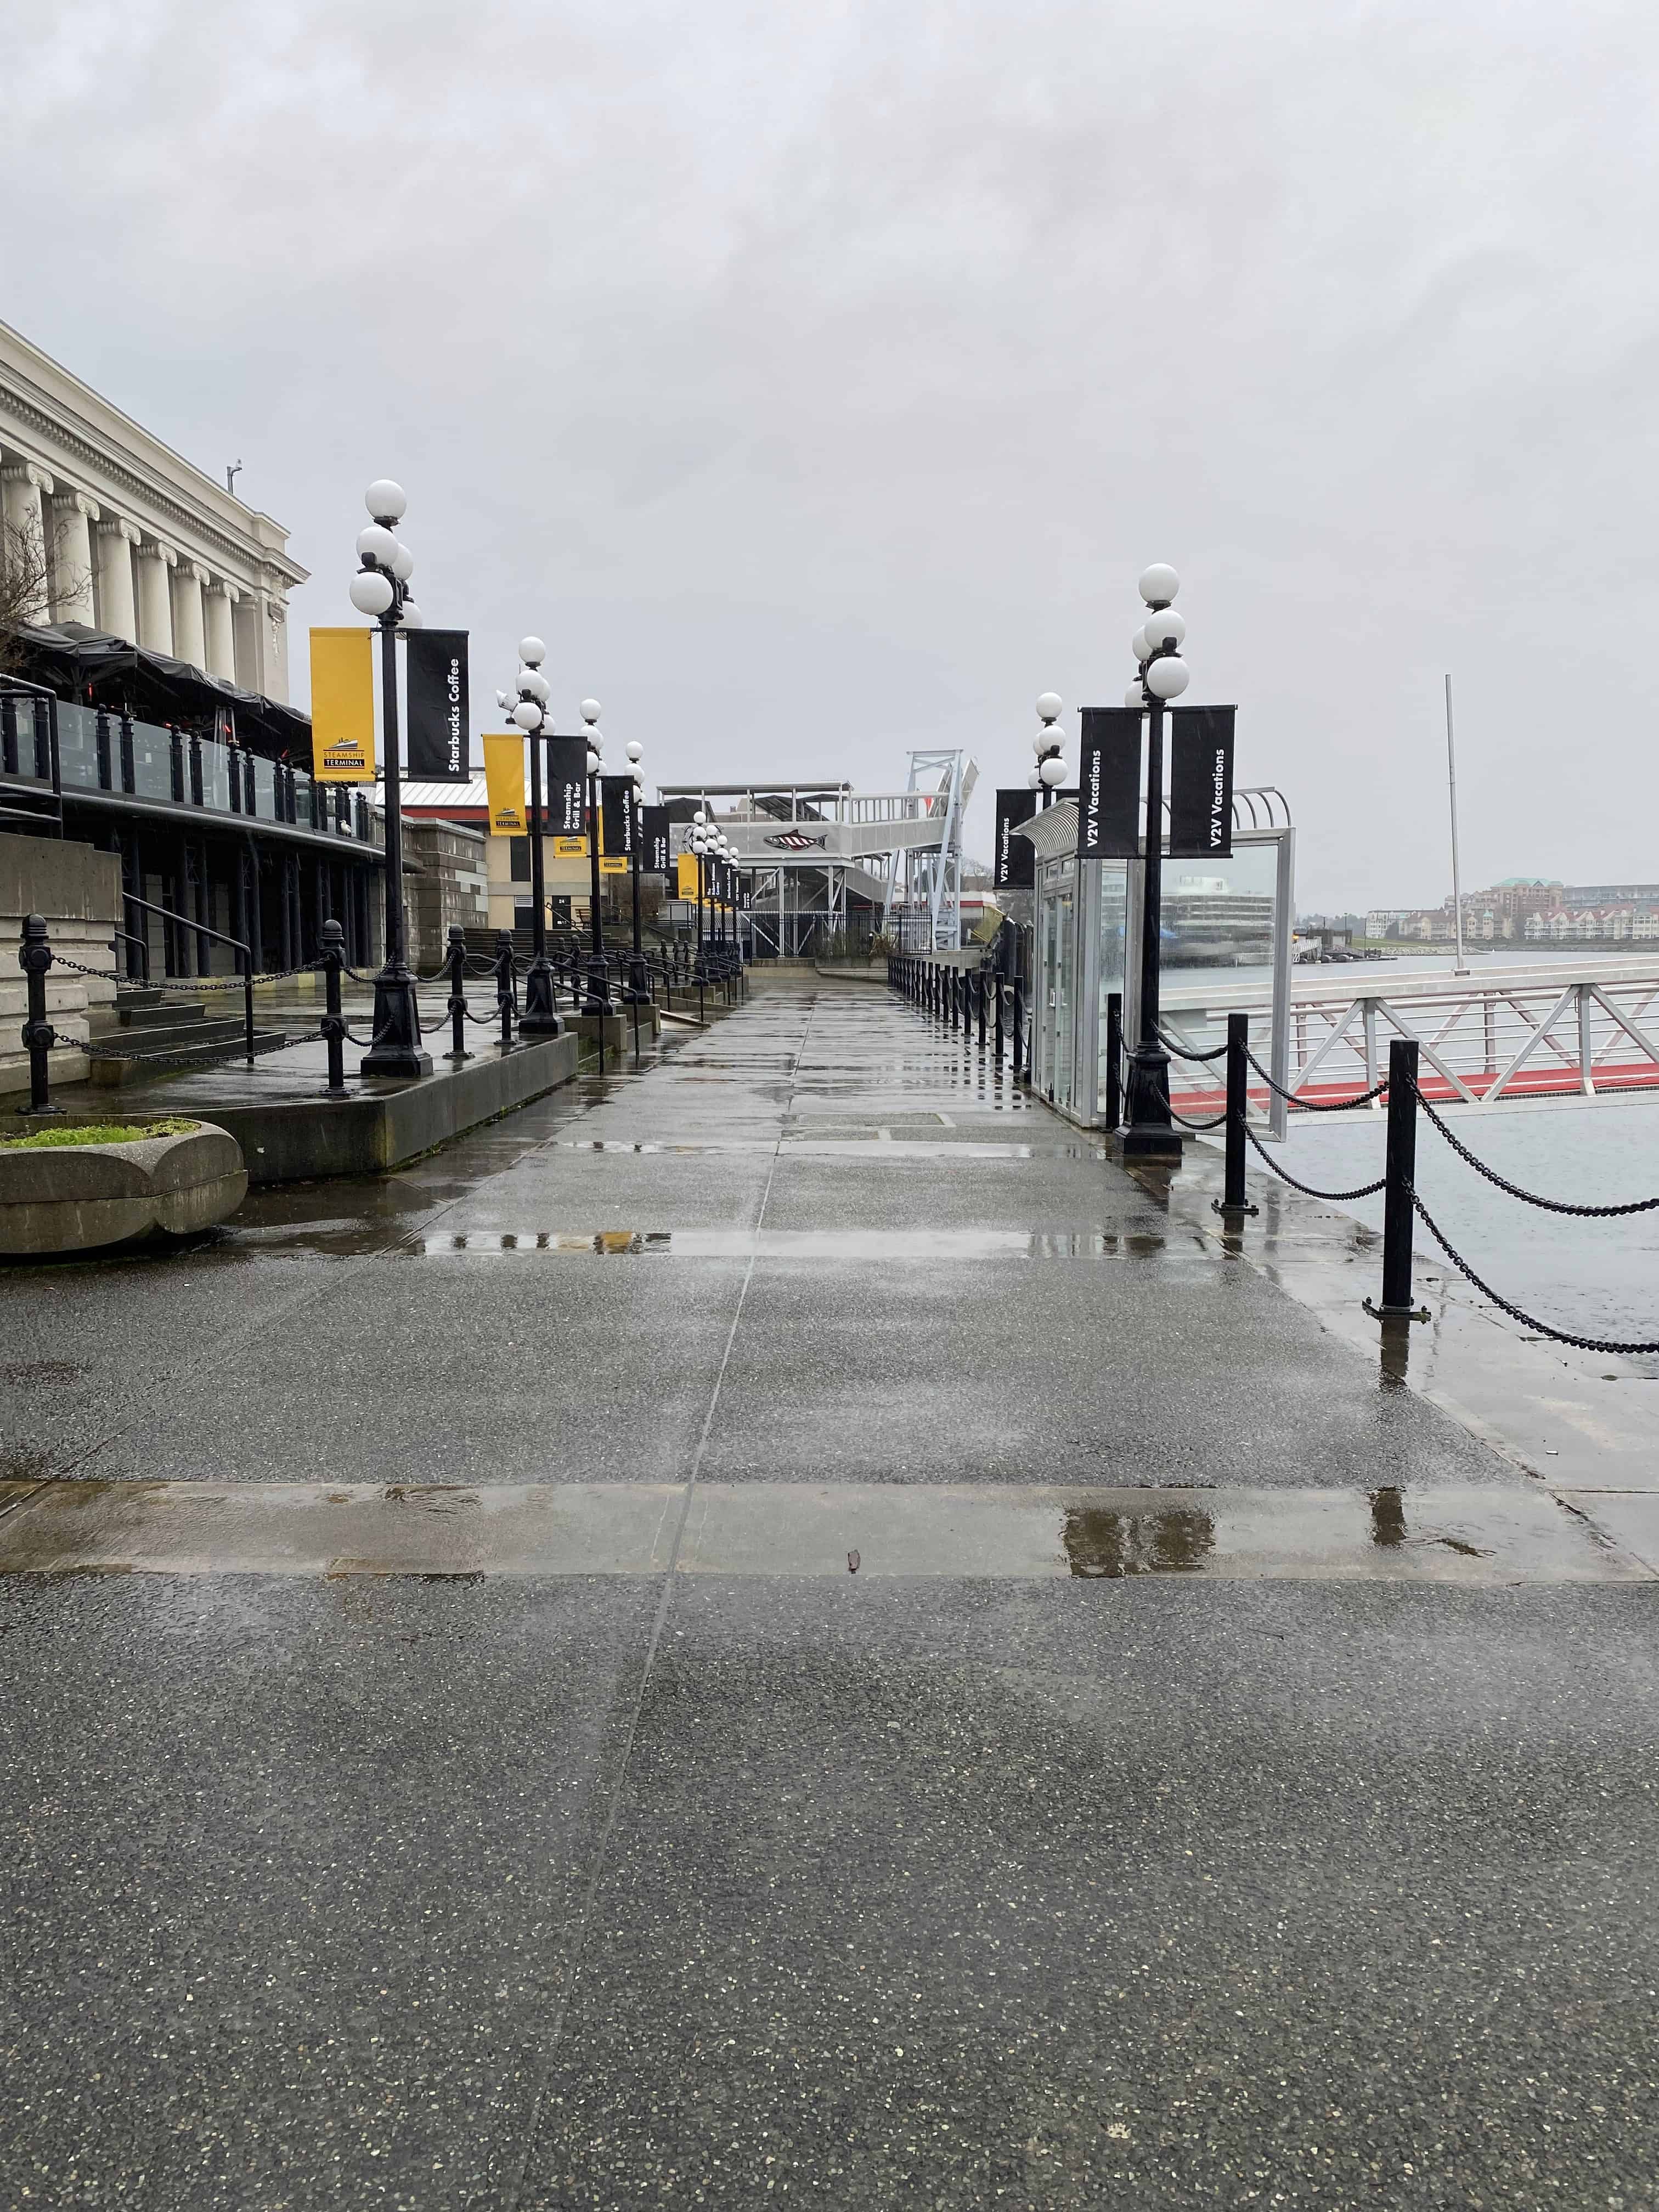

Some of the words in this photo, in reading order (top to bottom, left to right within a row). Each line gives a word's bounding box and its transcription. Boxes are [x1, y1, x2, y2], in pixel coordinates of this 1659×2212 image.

[447, 658, 460, 702] Coffee
[447, 706, 460, 772] Starbucks
[1088, 750, 1102, 815] Vacations
[1211, 749, 1224, 815] Vacations
[563, 783, 574, 830] Steamship
[1001, 817, 1010, 861] Vacations
[1087, 819, 1099, 848] V2V
[1210, 818, 1222, 847] V2V
[1000, 863, 1009, 882] V2V
